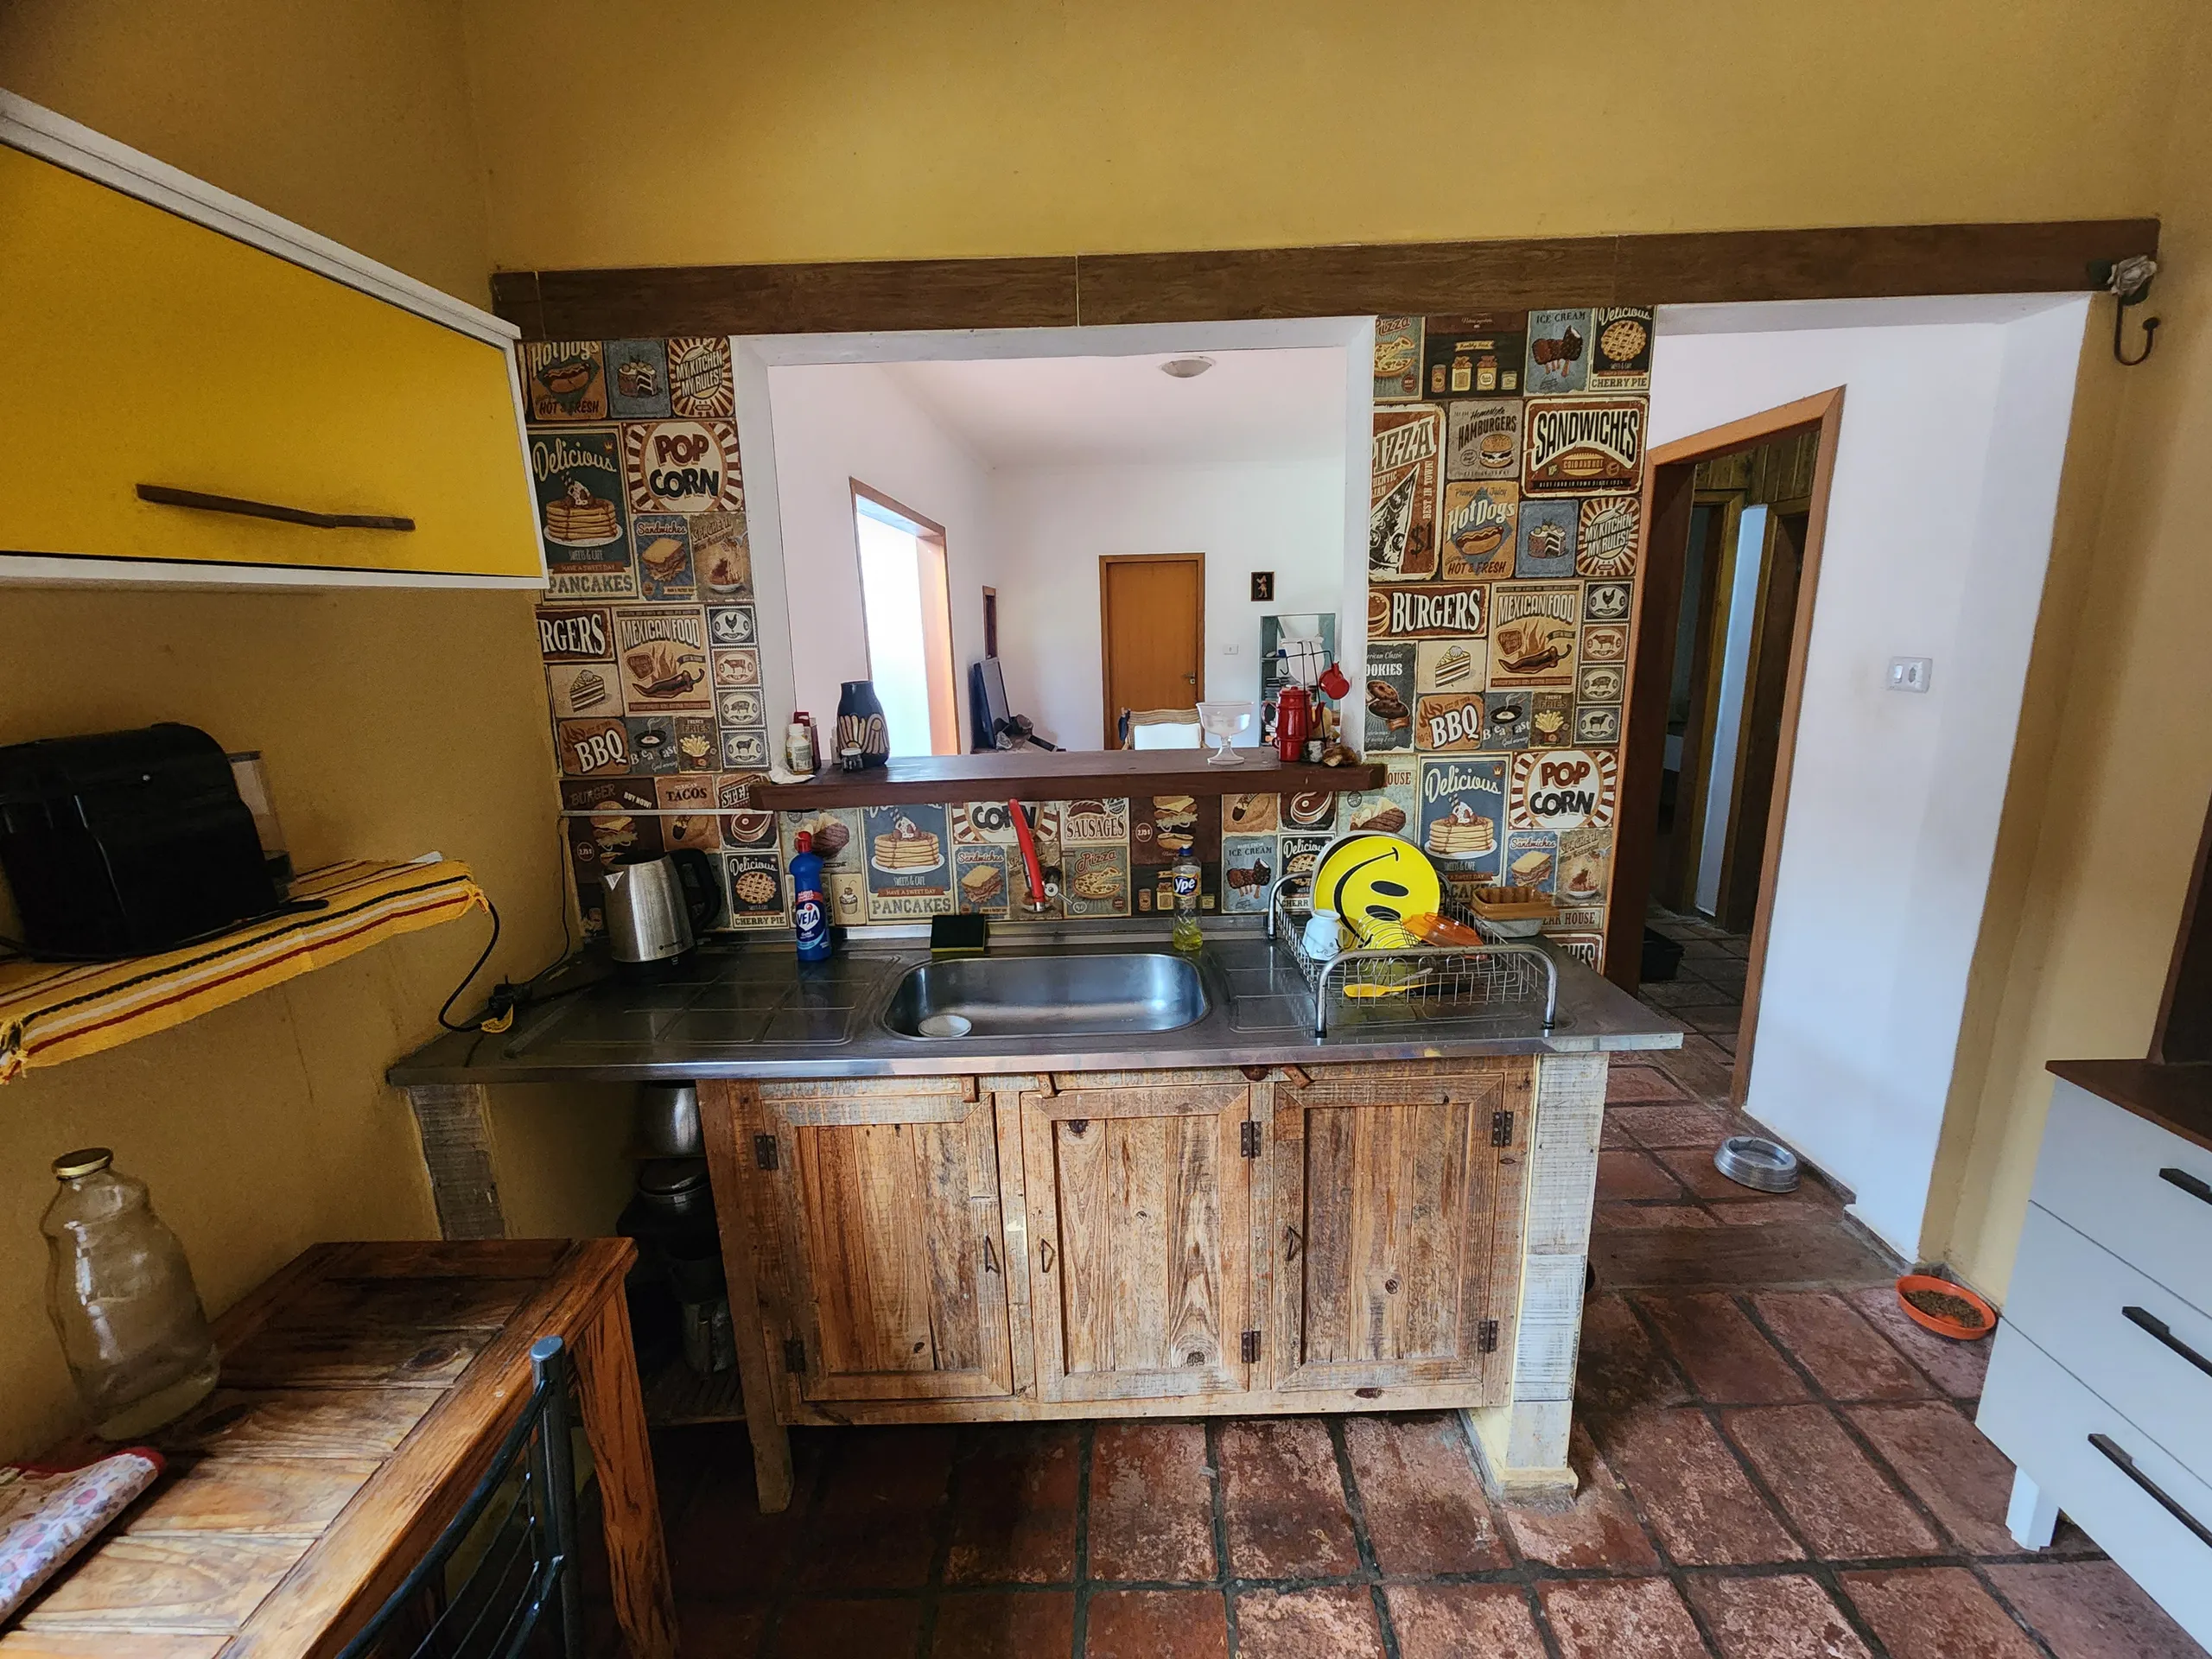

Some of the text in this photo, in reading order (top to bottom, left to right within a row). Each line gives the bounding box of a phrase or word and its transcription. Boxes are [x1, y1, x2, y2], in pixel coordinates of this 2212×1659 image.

[1536, 312, 1586, 323] ICE CREAM
[677, 362, 690, 380] MY
[682, 377, 696, 397] MY
[1592, 378, 1647, 387] CHERRY PIE
[539, 400, 599, 415] HOT RESH
[1459, 416, 1516, 451] HAMBURGERS
[1534, 410, 1638, 467] SANDWICHES
[653, 434, 709, 467] POP
[1372, 418, 1435, 474] IZZA
[533, 438, 616, 481] Delicious
[650, 468, 719, 499] CORN
[1424, 487, 1433, 497] IN
[1423, 499, 1432, 519] BEST
[637, 521, 688, 536] Sandwiches
[1446, 499, 1515, 542] Hot Dogs
[1585, 524, 1599, 542] MY
[1587, 537, 1602, 558] MY
[1447, 563, 1468, 575] HOT
[548, 575, 633, 594] PANCAKES
[1391, 589, 1481, 633] BURGERS
[1497, 594, 1575, 627] MEXICAN FOOD
[621, 618, 701, 652] MEXICAN FOOD
[1429, 704, 1478, 748] BBQ
[575, 729, 626, 772] BBQ
[1388, 772, 1411, 785] OUSE
[1426, 765, 1501, 804] Delicious
[1539, 760, 1591, 789] POP
[569, 783, 616, 806] BURGER
[623, 791, 636, 803] BUY
[665, 788, 707, 802] TACOS
[1529, 791, 1595, 817] CORN
[1067, 815, 1124, 838] SAUSAGES
[1229, 847, 1272, 857] ICE CREAM
[1283, 839, 1324, 859] Deliciou
[1510, 836, 1556, 849] Sandwiches
[730, 856, 778, 876] Delicious
[957, 850, 1004, 864] Sandwiches
[1076, 850, 1117, 874] Pizza
[872, 898, 950, 915] PANCAKES
[735, 917, 771, 925] CHERRY
[797, 910, 819, 925] VEJA
[1565, 912, 1596, 925] HOUSE
